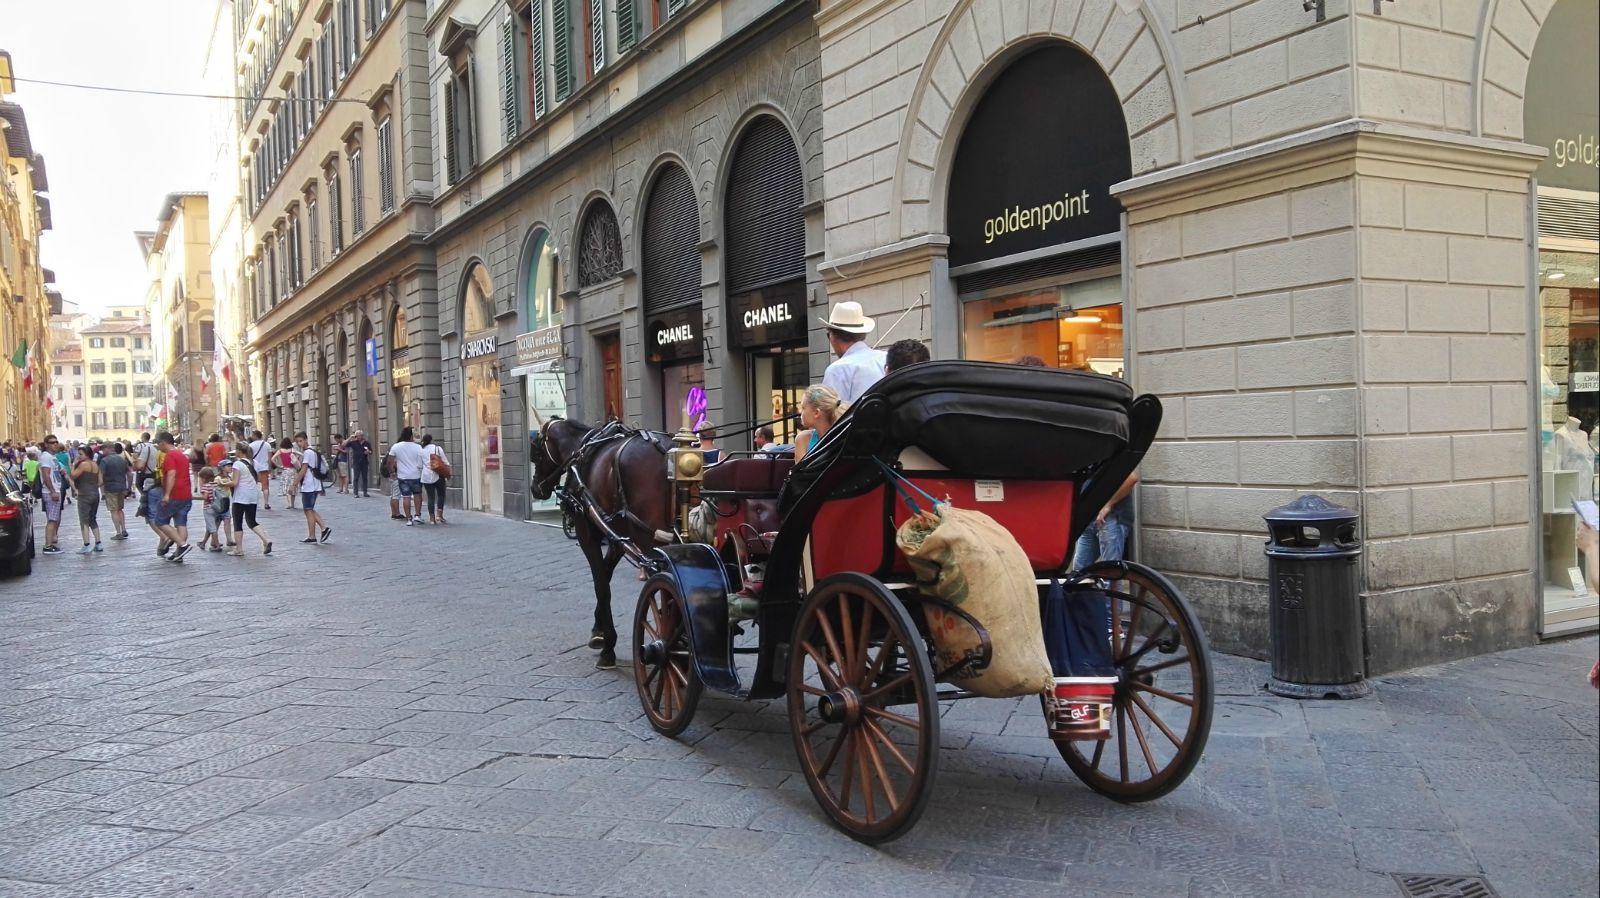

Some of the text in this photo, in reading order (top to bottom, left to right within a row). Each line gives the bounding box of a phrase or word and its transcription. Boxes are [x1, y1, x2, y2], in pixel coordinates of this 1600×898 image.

[984, 190, 1090, 244] goldenpoint
[743, 302, 792, 328] CHANEL
[657, 324, 693, 345] CHANEL
[466, 336, 496, 358] SWAROVSKI
[1070, 704, 1090, 720] GLF
